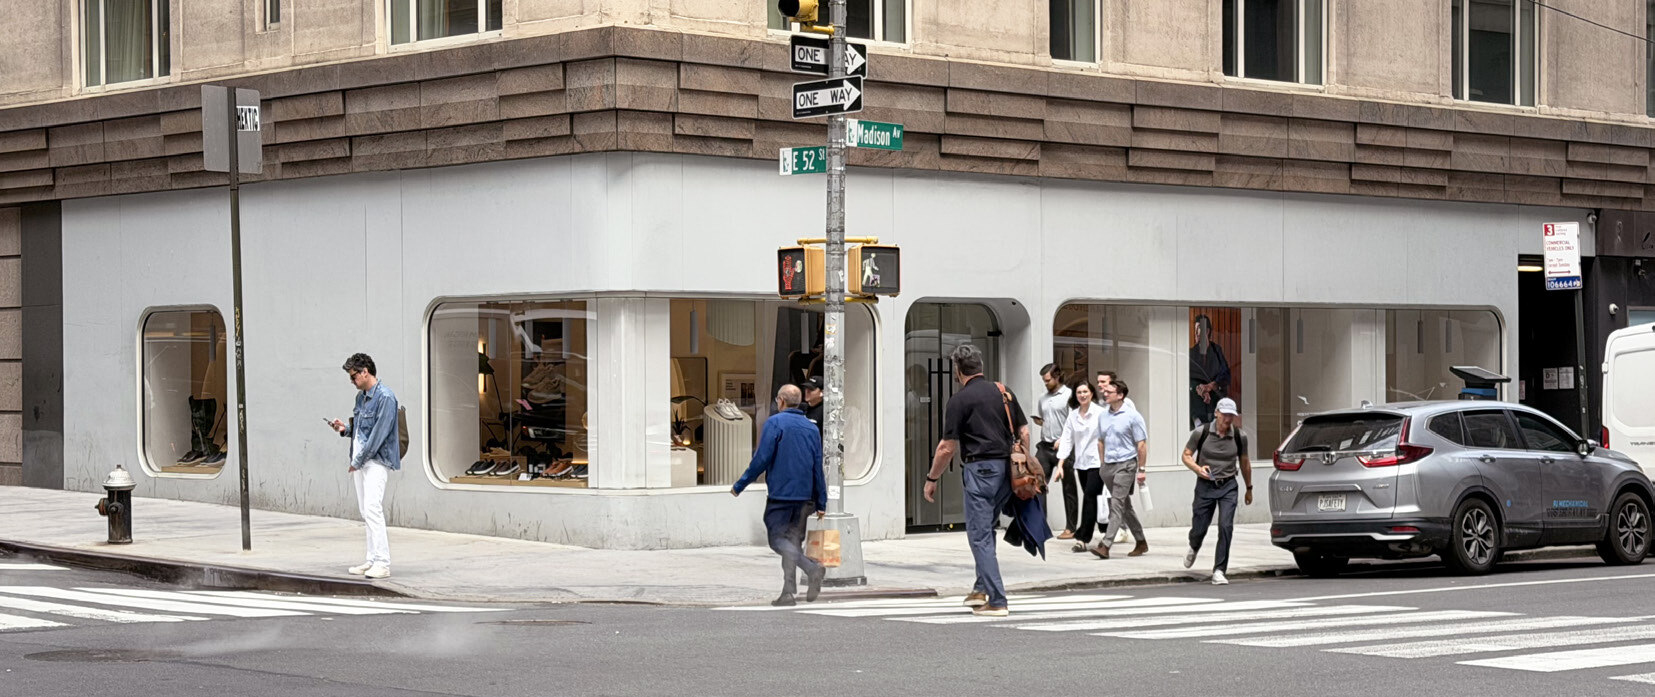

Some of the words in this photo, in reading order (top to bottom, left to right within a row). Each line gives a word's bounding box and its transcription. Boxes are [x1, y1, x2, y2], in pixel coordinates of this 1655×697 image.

[798, 47, 820, 62] ONE
[845, 53, 857, 66] AY
[799, 92, 819, 107] ONE
[830, 87, 853, 103] WAY
[857, 123, 890, 147] Madison
[892, 126, 901, 139] Av
[793, 151, 799, 171] E
[802, 150, 815, 171] 52
[818, 148, 826, 161] St
[1547, 225, 1553, 235] 3
